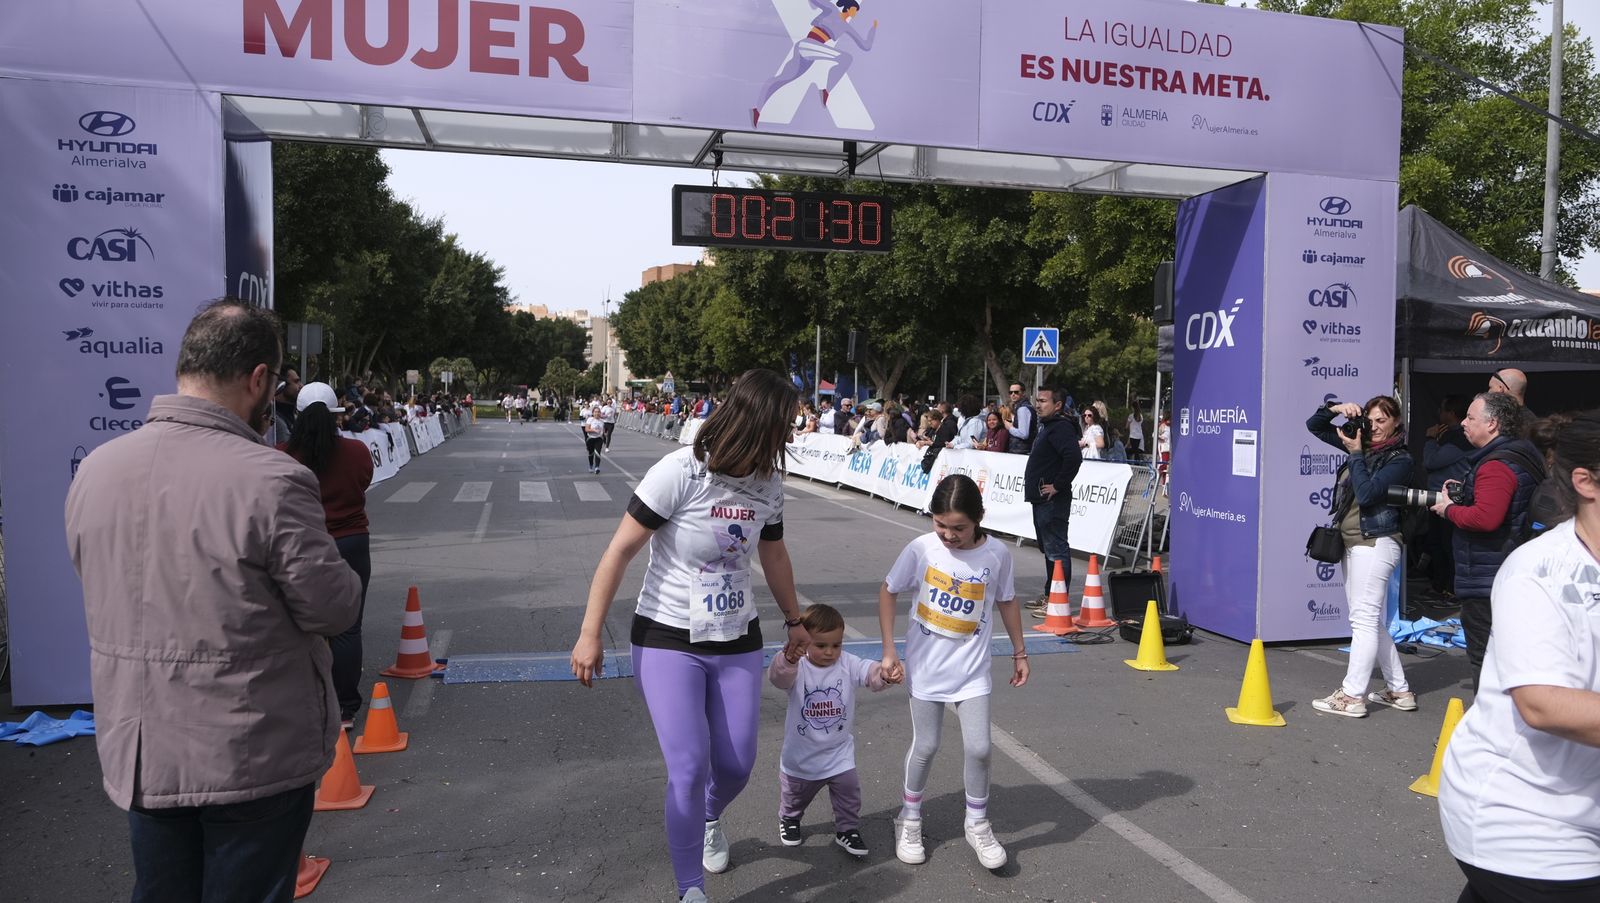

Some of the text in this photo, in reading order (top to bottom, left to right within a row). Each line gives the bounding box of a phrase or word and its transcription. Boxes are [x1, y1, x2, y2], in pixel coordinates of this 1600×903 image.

[243, 0, 590, 83] MUJER
[1064, 16, 1232, 57] LA IGUALDAD
[1020, 53, 1270, 101] ES NUESTRA META.
[1032, 100, 1076, 124] CDX
[1122, 104, 1168, 122] ALMERÍA
[1122, 119, 1146, 128] CIUDAD
[57, 138, 158, 156] HYUNDAI
[71, 155, 147, 169] Almerialva
[84, 187, 166, 206] cajamar
[1307, 216, 1363, 229] HYUNDAI
[1313, 228, 1357, 239] Almerialva
[67, 234, 138, 262] CASI
[1320, 252, 1366, 266] cajamar
[91, 280, 164, 298] vithas
[1308, 287, 1348, 309] CASI
[91, 300, 109, 308] vivir
[110, 301, 129, 309] para
[1185, 298, 1244, 351] CDX
[1320, 321, 1361, 335] vithas
[79, 336, 164, 358] aqualia
[1311, 363, 1359, 380] aqualia
[89, 416, 144, 431] Clece
[1197, 405, 1248, 424] ALMERÍA
[1196, 424, 1221, 435] CIUDAD
[710, 505, 756, 521] MUJER
[703, 590, 744, 613] 1068
[929, 587, 975, 615] 1809
[804, 707, 842, 718] RUNNER
[811, 700, 833, 710] MINI
